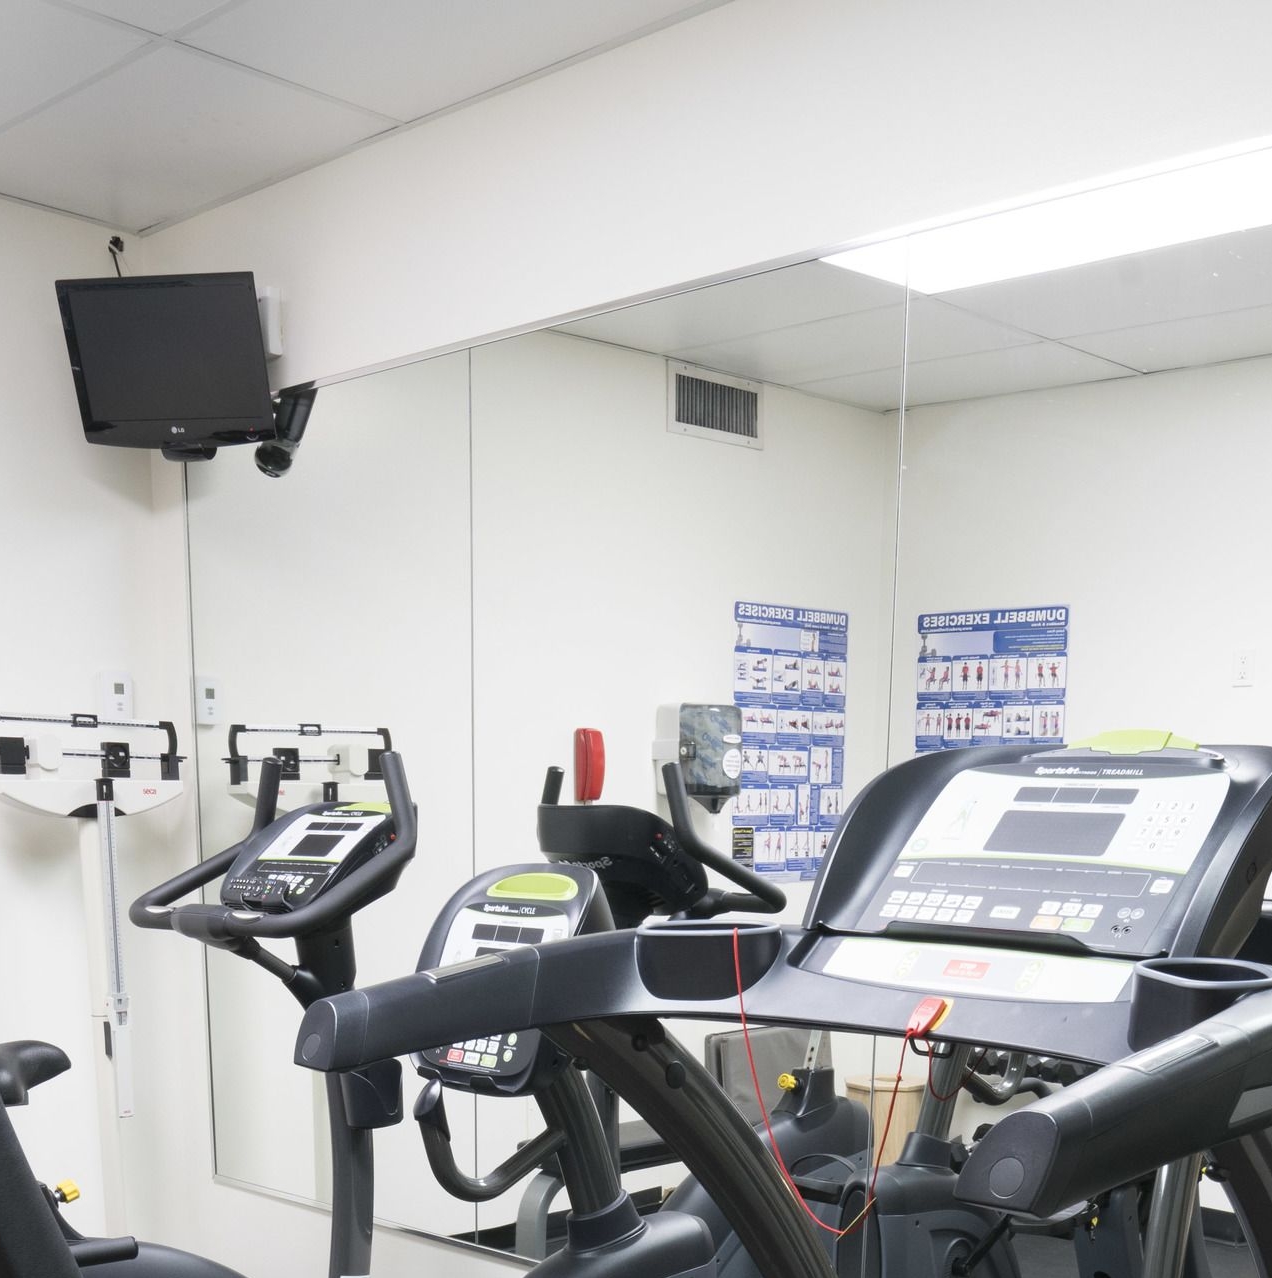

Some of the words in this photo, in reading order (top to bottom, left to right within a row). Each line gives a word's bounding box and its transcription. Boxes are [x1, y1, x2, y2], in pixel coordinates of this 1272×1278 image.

[1034, 766, 1080, 776] SportsArt
[1102, 768, 1145, 776] TREADMILL
[143, 788, 157, 796] seca
[484, 903, 510, 913] SportsArt
[521, 907, 537, 915] CYCLE
